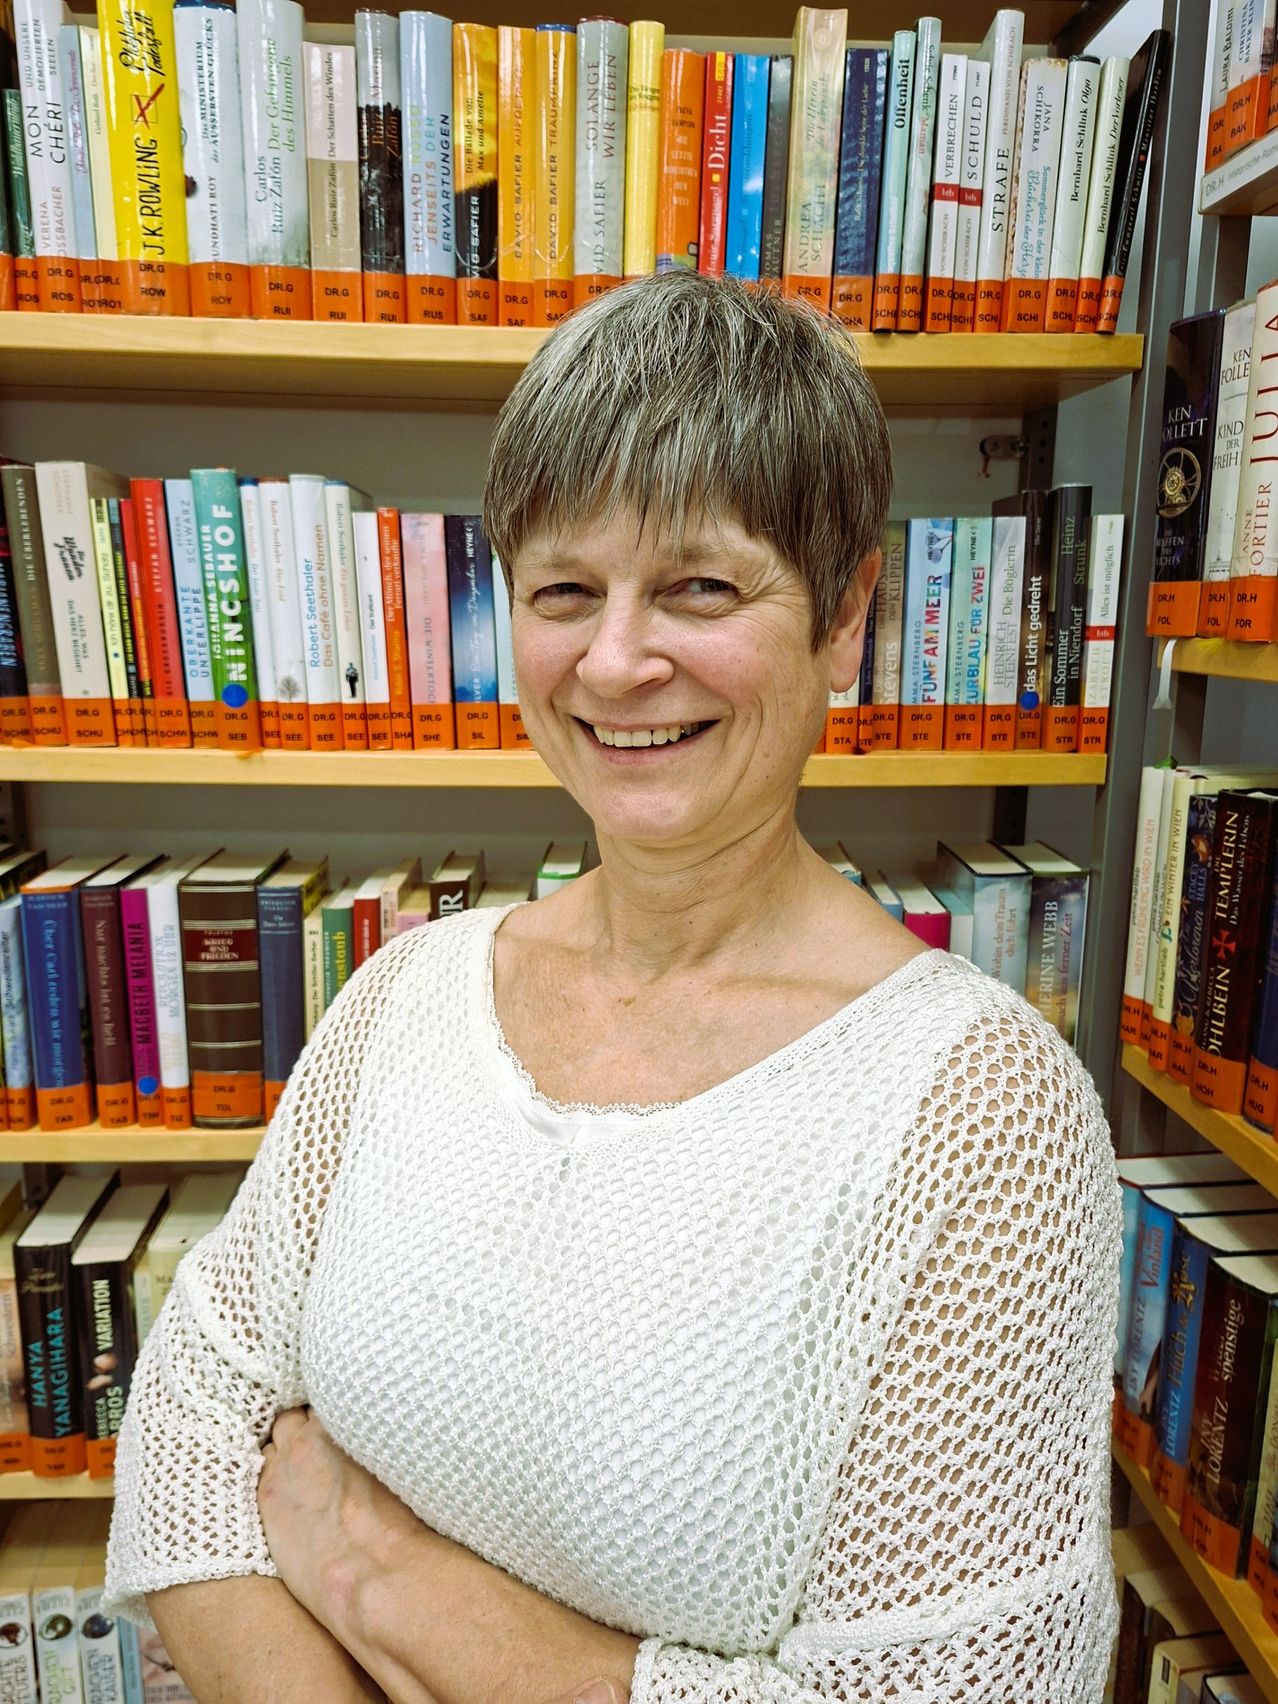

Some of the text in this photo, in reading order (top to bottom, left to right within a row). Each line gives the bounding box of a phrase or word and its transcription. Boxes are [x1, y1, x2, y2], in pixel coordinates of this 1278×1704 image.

[21, 21, 33, 87] UND UNSERE
[33, 19, 46, 91] DEMOLIERTEN
[48, 39, 57, 76] SEELEN
[136, 14, 165, 76] Todesfall
[325, 52, 333, 85] Windes
[1220, 8, 1234, 92] LAURA BALDINI
[196, 41, 208, 122] MINISTERIUM
[280, 56, 295, 152] des Himmels
[586, 61, 599, 151] SOLANGE
[604, 54, 617, 158] WIR LEBEN
[894, 58, 910, 128] Offenheit
[26, 105, 43, 157] MON
[43, 102, 65, 163] CHÉRI
[268, 123, 280, 150] Der
[327, 103, 335, 139] Schatten
[465, 118, 473, 154] Ballade
[475, 90, 485, 170] Max und Amelie
[708, 114, 727, 169] Dicht
[919, 116, 929, 154] Maman
[945, 94, 958, 177] VERBRECHEN
[967, 96, 982, 180] SCHULD
[1032, 86, 1043, 152] SCHIKORRA
[1043, 103, 1051, 131] JANA
[1070, 79, 1092, 202] Bernhard Schlink Olga
[254, 156, 267, 202] Carlos
[425, 117, 437, 245] JENSEITS DER
[440, 114, 452, 252] ERWARTUNGEN
[465, 156, 473, 173] Die
[514, 155, 522, 205] SAFIER
[992, 148, 1009, 232] STRAFE
[1098, 186, 1110, 233] Bernhard
[1104, 144, 1116, 183] Schlink
[269, 157, 283, 234] Ruiz Zafón
[412, 173, 424, 253] RICHARD
[549, 155, 557, 259] DAVID SAFIER
[812, 182, 826, 262] SCHACHT
[40, 201, 51, 249] VERENA
[330, 211, 338, 238] Carlos
[798, 203, 810, 272] ANDREA
[140, 264, 164, 273] DR.G
[141, 288, 165, 297] ROW
[1019, 291, 1041, 299] DR.G
[274, 306, 291, 315] RUI
[470, 314, 487, 322] SAF
[1017, 313, 1038, 321] SCHI
[1233, 347, 1251, 362] KEN
[1169, 404, 1191, 422] KEN
[1218, 420, 1243, 440] KIND
[1226, 439, 1240, 449] DER
[181, 500, 195, 563] SCHWARZ
[382, 526, 390, 554] seinen
[1061, 516, 1075, 555] Heinz
[1242, 509, 1252, 553] ANNE
[391, 539, 403, 609] Ferrari verkaufte
[889, 543, 902, 601] KLIPPEN
[1002, 545, 1017, 616] Die Büglerin
[1074, 539, 1086, 584] Strunk
[1104, 545, 1115, 581] möglich
[202, 525, 222, 659] JOHANNA SEBAUER
[303, 558, 320, 668] Robert Seethaler
[314, 525, 333, 668] Das Café ohne Namen
[387, 606, 396, 622] Der
[1100, 597, 1110, 619] Alles
[1158, 594, 1174, 603] DR.H
[1158, 616, 1171, 625] FOL
[180, 586, 199, 678] OBERKANTE
[191, 588, 209, 678] UNTERLIPPE
[913, 620, 921, 675] STERNBERG
[920, 575, 942, 703] FÜNF AM MEER
[955, 621, 964, 677] STERNBERG
[970, 608, 982, 634] FÜR
[1024, 576, 1042, 692] das Licht gedreht
[1068, 605, 1083, 679] in Niendorf
[1236, 618, 1251, 628] FOR
[1053, 629, 1068, 707] Ein Sommer
[225, 712, 248, 721] DR.G
[229, 733, 247, 741] SEB
[1172, 809, 1181, 837] WIEN
[1172, 839, 1179, 853] IN
[1167, 856, 1177, 895] WINTER
[1195, 868, 1207, 901] HALLS
[1214, 811, 1239, 920] TEMPLERIN
[1042, 900, 1058, 949] WEBB
[128, 923, 150, 1045] MACBETH MELANIA
[1158, 948, 1168, 1010] petra hartlieb
[1196, 1083, 1214, 1097] HOH
[1198, 1060, 1217, 1076] DR.H
[92, 1279, 114, 1350] VARIATION
[1221, 1299, 1243, 1382] spenstige
[28, 1341, 46, 1408] HANYA
[47, 1307, 71, 1437] YANAGIHARA
[1165, 1391, 1181, 1456] LORENTZ
[1206, 1396, 1229, 1485] LORENTZ
